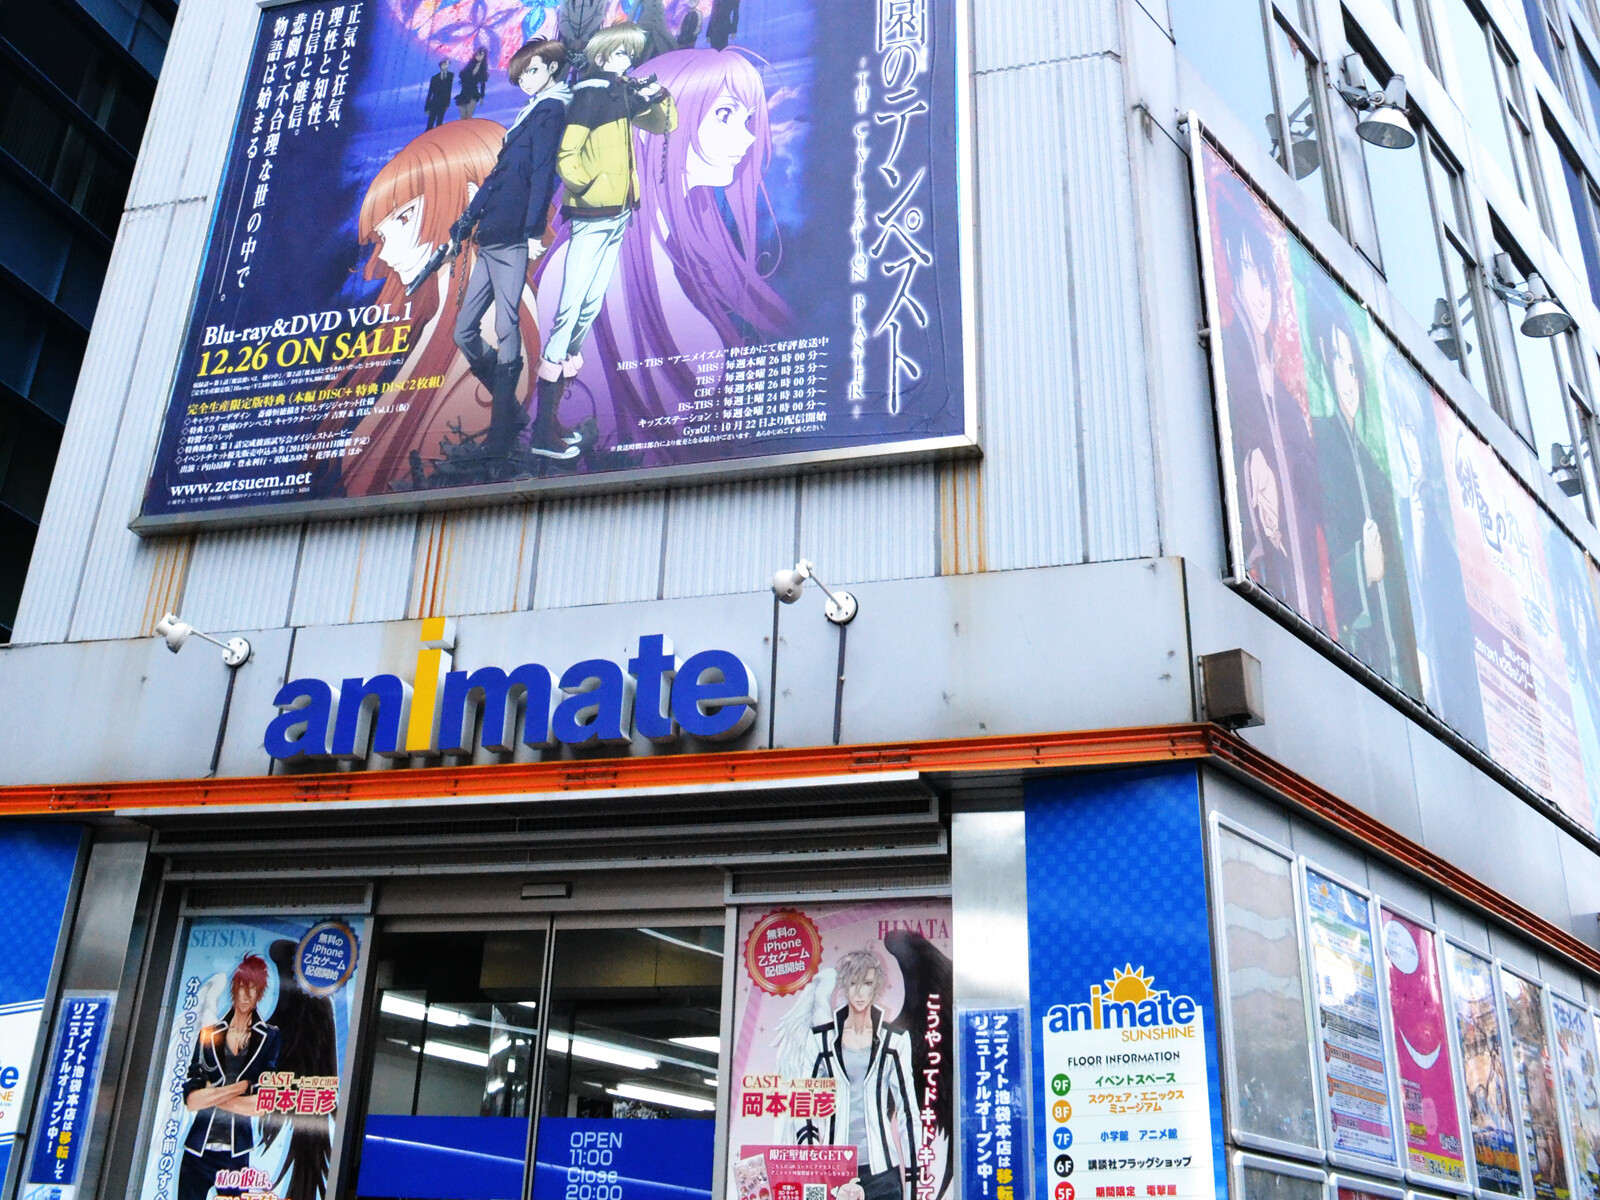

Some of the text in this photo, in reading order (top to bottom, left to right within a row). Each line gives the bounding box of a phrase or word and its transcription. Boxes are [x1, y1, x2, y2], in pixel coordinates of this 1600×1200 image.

[202, 301, 412, 347] Blu-ray&DVD VOL.1
[196, 325, 412, 377] 12.26 ON SALE
[850, 295, 868, 400] BLASTER
[170, 471, 313, 497] www.zetsuem.net
[264, 616, 757, 761] animate
[766, 927, 797, 941] 無料の
[877, 919, 950, 941] HINATA
[188, 928, 257, 950] SETSUNA
[318, 932, 344, 947] 無料の
[764, 938, 802, 952] iPhone
[311, 943, 345, 958] iPhone
[758, 947, 811, 967] 乙女ゲーム
[303, 953, 346, 971] 乙女ゲーム
[764, 961, 806, 978] 配信開始
[305, 965, 339, 981] 配信開始
[1048, 985, 1197, 1033] animate
[1121, 1026, 1195, 1042] SUNSHINE
[1067, 1051, 1181, 1067] FLOOR INFORMATION
[258, 1071, 296, 1087] CAST
[742, 1074, 782, 1089] CAST
[1053, 1073, 1176, 1092] 9F イベントスペース
[255, 1088, 337, 1115] 岡本信彦
[741, 1091, 837, 1118] 岡本信彦
[1088, 1090, 1185, 1104] スクウェア・エニックス
[1053, 1102, 1163, 1119] 8F ミュージアム
[570, 1132, 623, 1149] OPEN
[1055, 1128, 1178, 1146] 7F 小学館 アニメ館
[569, 1149, 613, 1166] 11:00
[1055, 1156, 1192, 1173] 6F 講談社フラッグショップ
[567, 1167, 618, 1183] Close
[566, 1184, 623, 1200] 20:00
[1056, 1187, 1073, 1200] 5F
